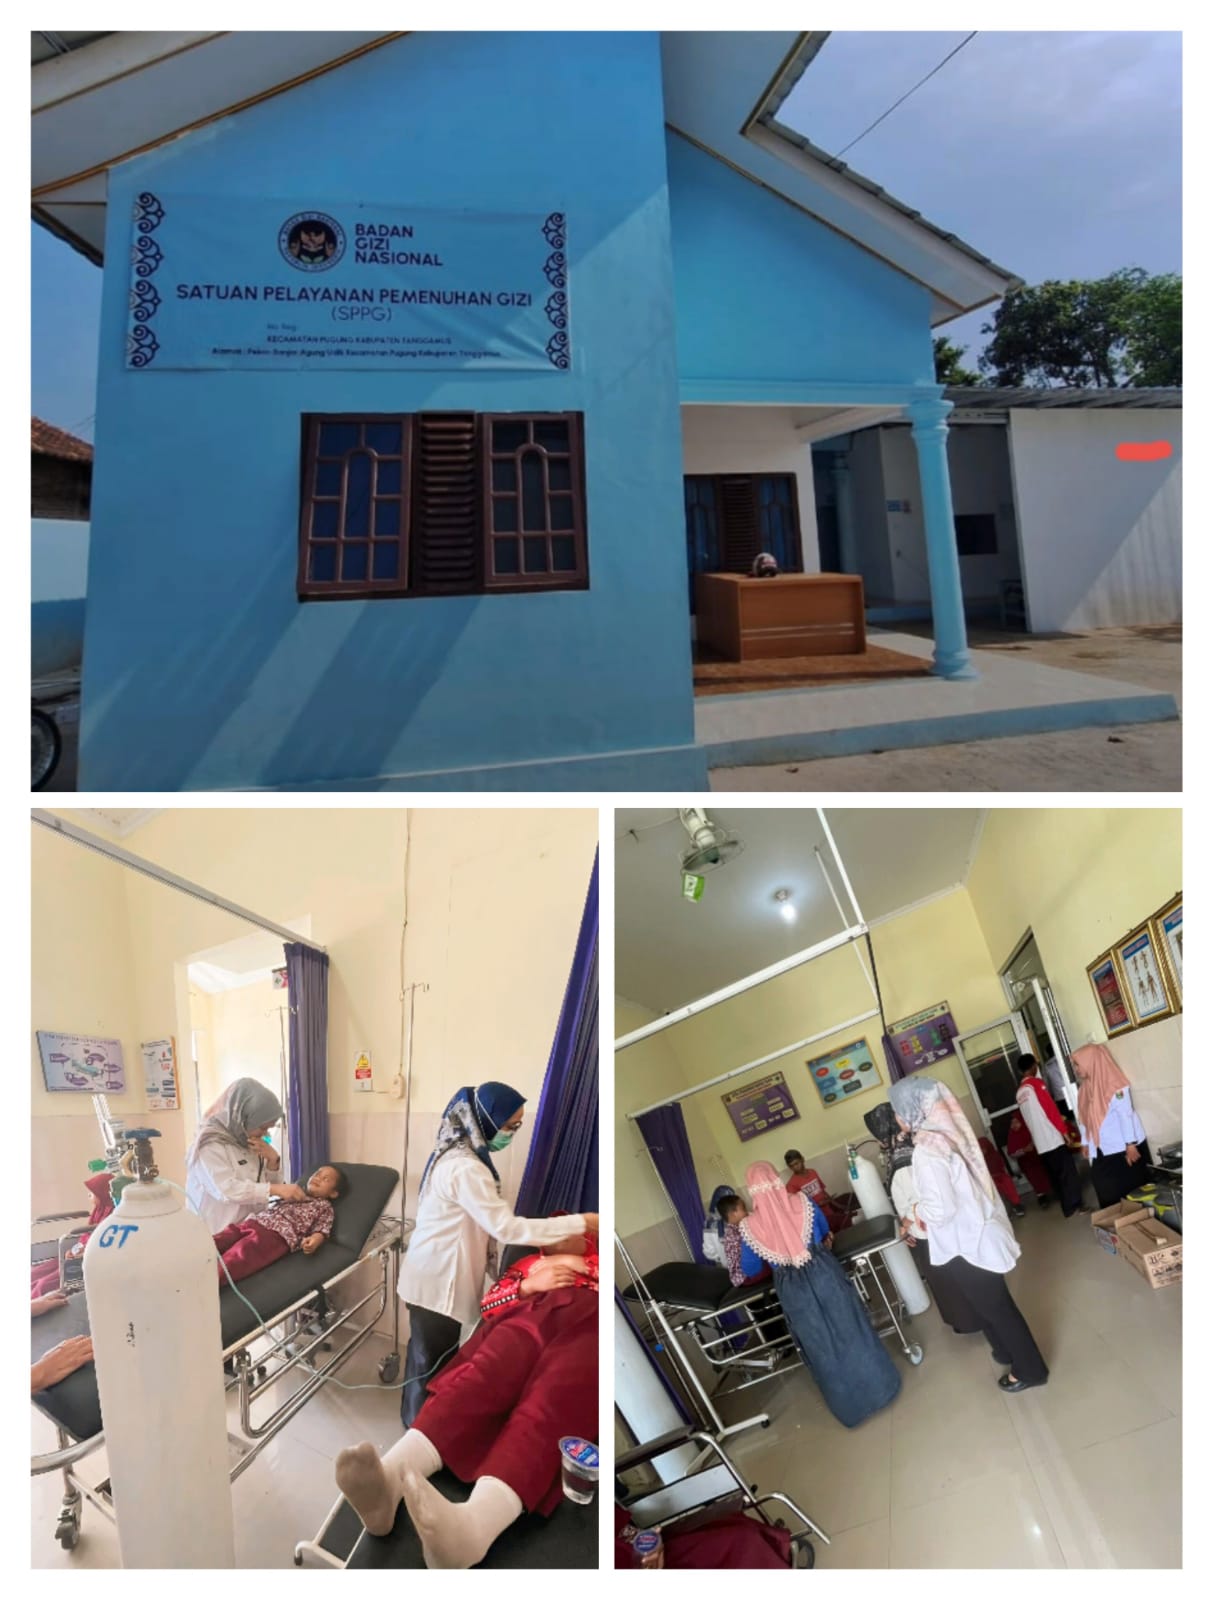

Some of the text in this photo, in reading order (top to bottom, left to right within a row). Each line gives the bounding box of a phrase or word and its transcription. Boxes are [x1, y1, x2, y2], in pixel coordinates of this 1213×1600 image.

[355, 224, 413, 238] BADAN
[355, 237, 390, 251] GIZI
[355, 252, 444, 267] NASIONAL
[176, 284, 532, 307] SATUAN PELAYANAN PEMENUHAN GIZI
[331, 305, 392, 322] (SPPG)
[267, 335, 318, 344] KECAMATAN
[320, 335, 354, 344] PUGUNG
[356, 336, 400, 345] KABUPATEN
[300, 348, 325, 358] Agung
[99, 1224, 139, 1249] GT
